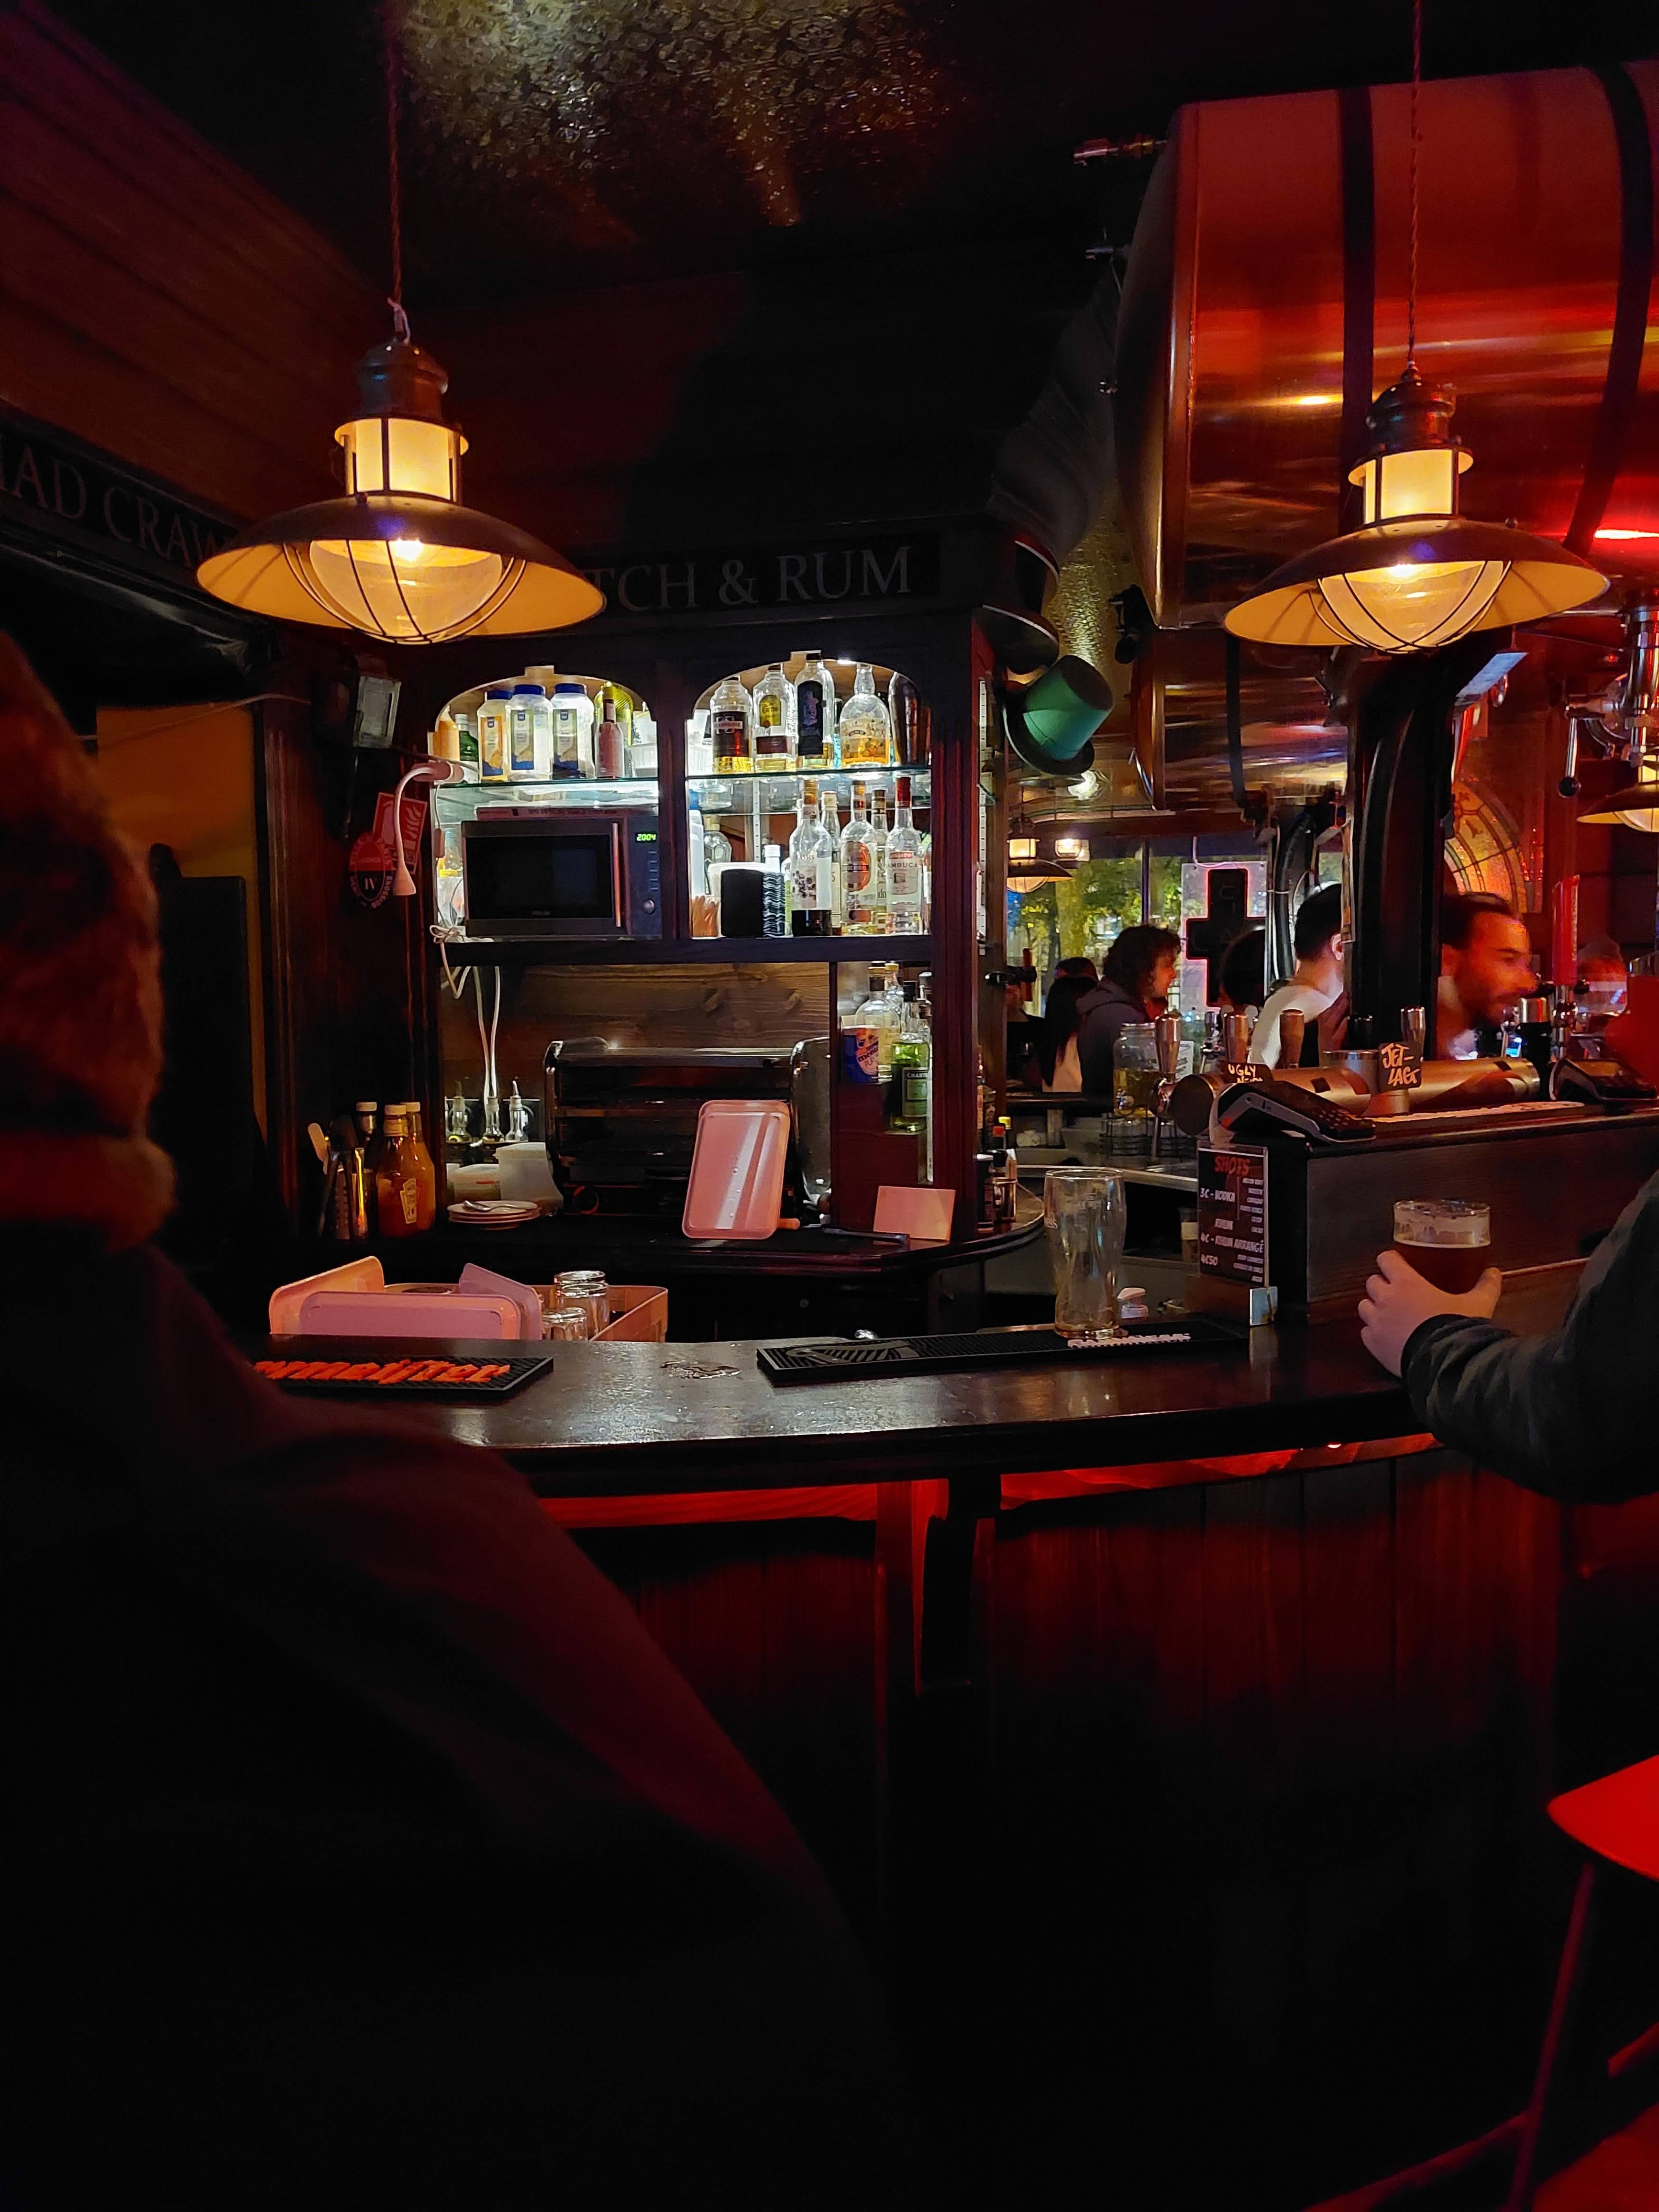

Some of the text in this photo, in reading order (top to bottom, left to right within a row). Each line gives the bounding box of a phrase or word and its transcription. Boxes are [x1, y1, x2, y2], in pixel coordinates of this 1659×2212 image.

[0, 433, 87, 520] AD
[719, 559, 759, 606] &
[776, 544, 912, 602] RUM
[1228, 1063, 1256, 1077] UGLY
[1388, 1066, 1420, 1086] LAG
[1214, 1155, 1251, 1176] SHOTS
